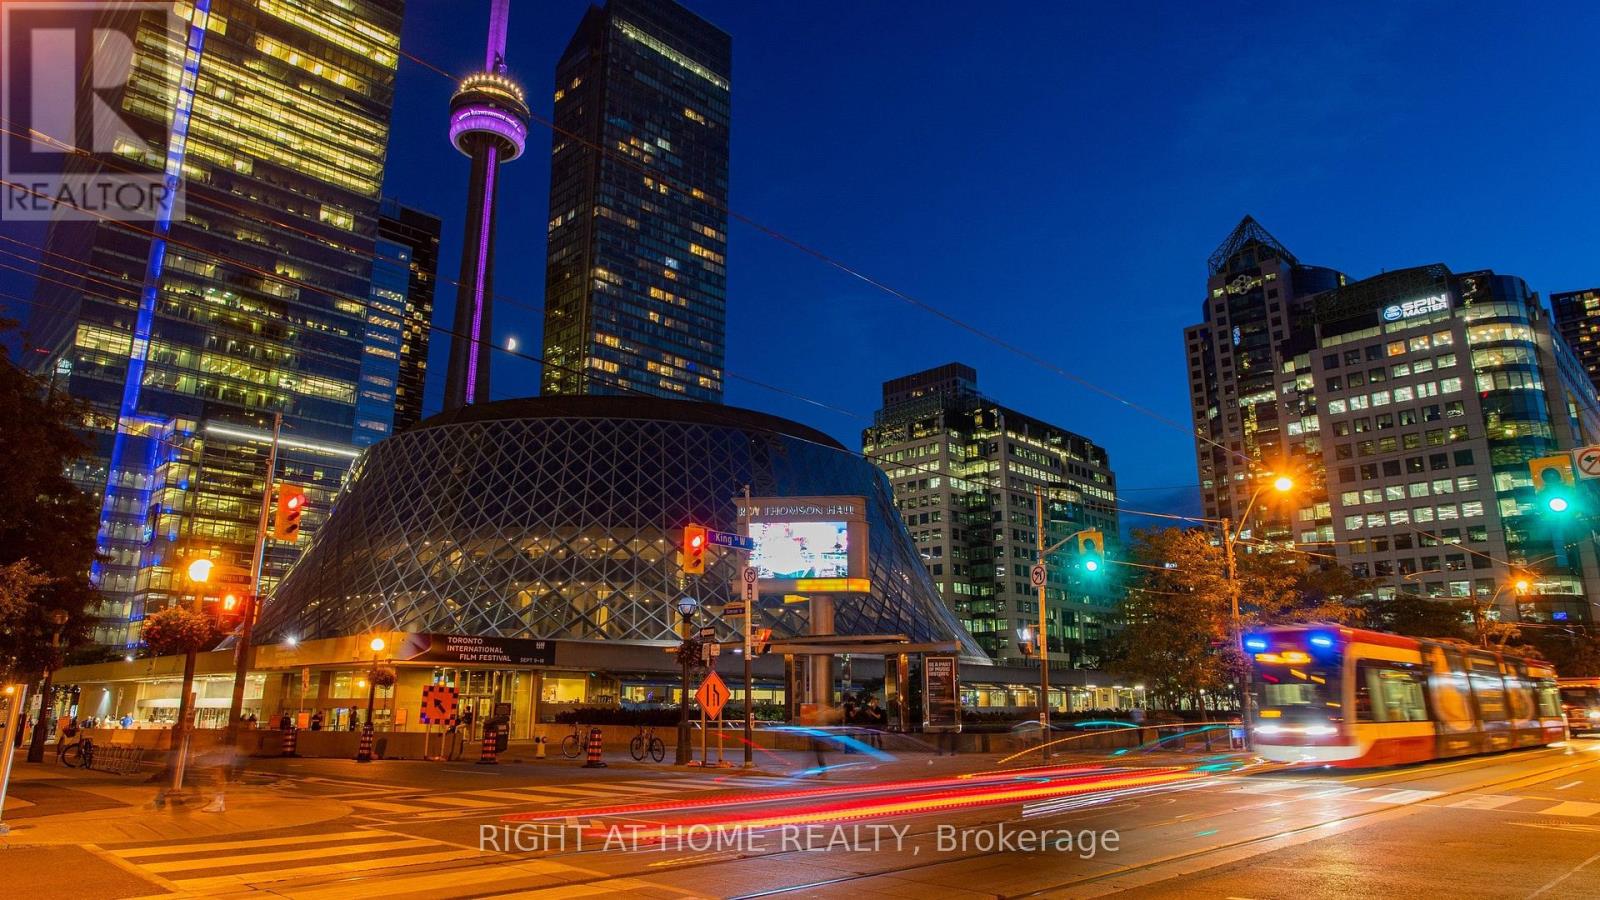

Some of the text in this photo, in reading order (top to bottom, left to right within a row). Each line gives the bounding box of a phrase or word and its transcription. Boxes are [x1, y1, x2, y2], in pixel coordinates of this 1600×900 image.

[1401, 294, 1446, 309] SPIN
[1403, 302, 1448, 318] MASTER
[739, 504, 854, 516] RY THOMSON HALL
[715, 532, 732, 546] King
[740, 536, 746, 545] W
[448, 637, 483, 645] TORONTO
[447, 645, 503, 654] INTERNATIONAL
[479, 654, 511, 662] FESTIVAL
